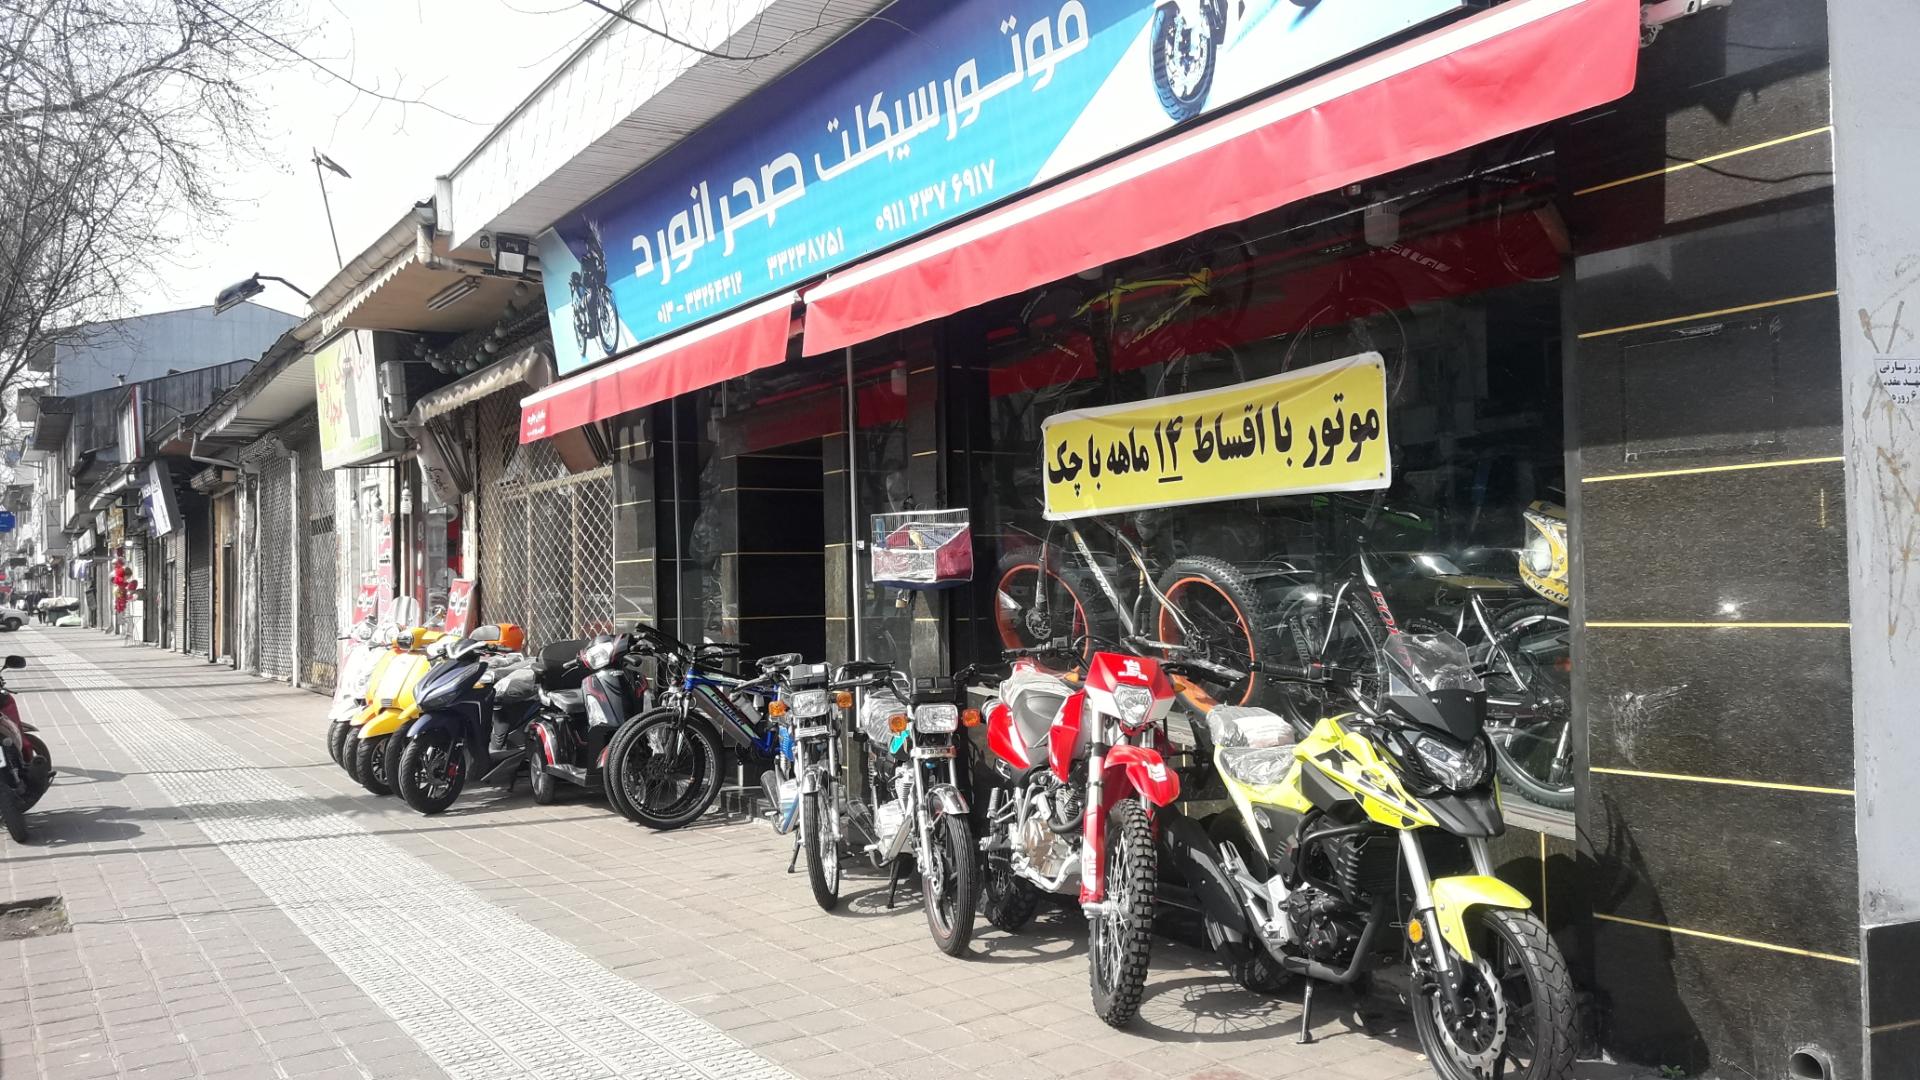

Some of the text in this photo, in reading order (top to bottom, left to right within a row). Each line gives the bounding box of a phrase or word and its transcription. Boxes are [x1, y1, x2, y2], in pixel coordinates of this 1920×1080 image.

[632, 0, 1089, 285] موتورسیکلت صحرانورد
[1047, 393, 1381, 496] موتور با اقساط ۱۴ ماهه با چک
